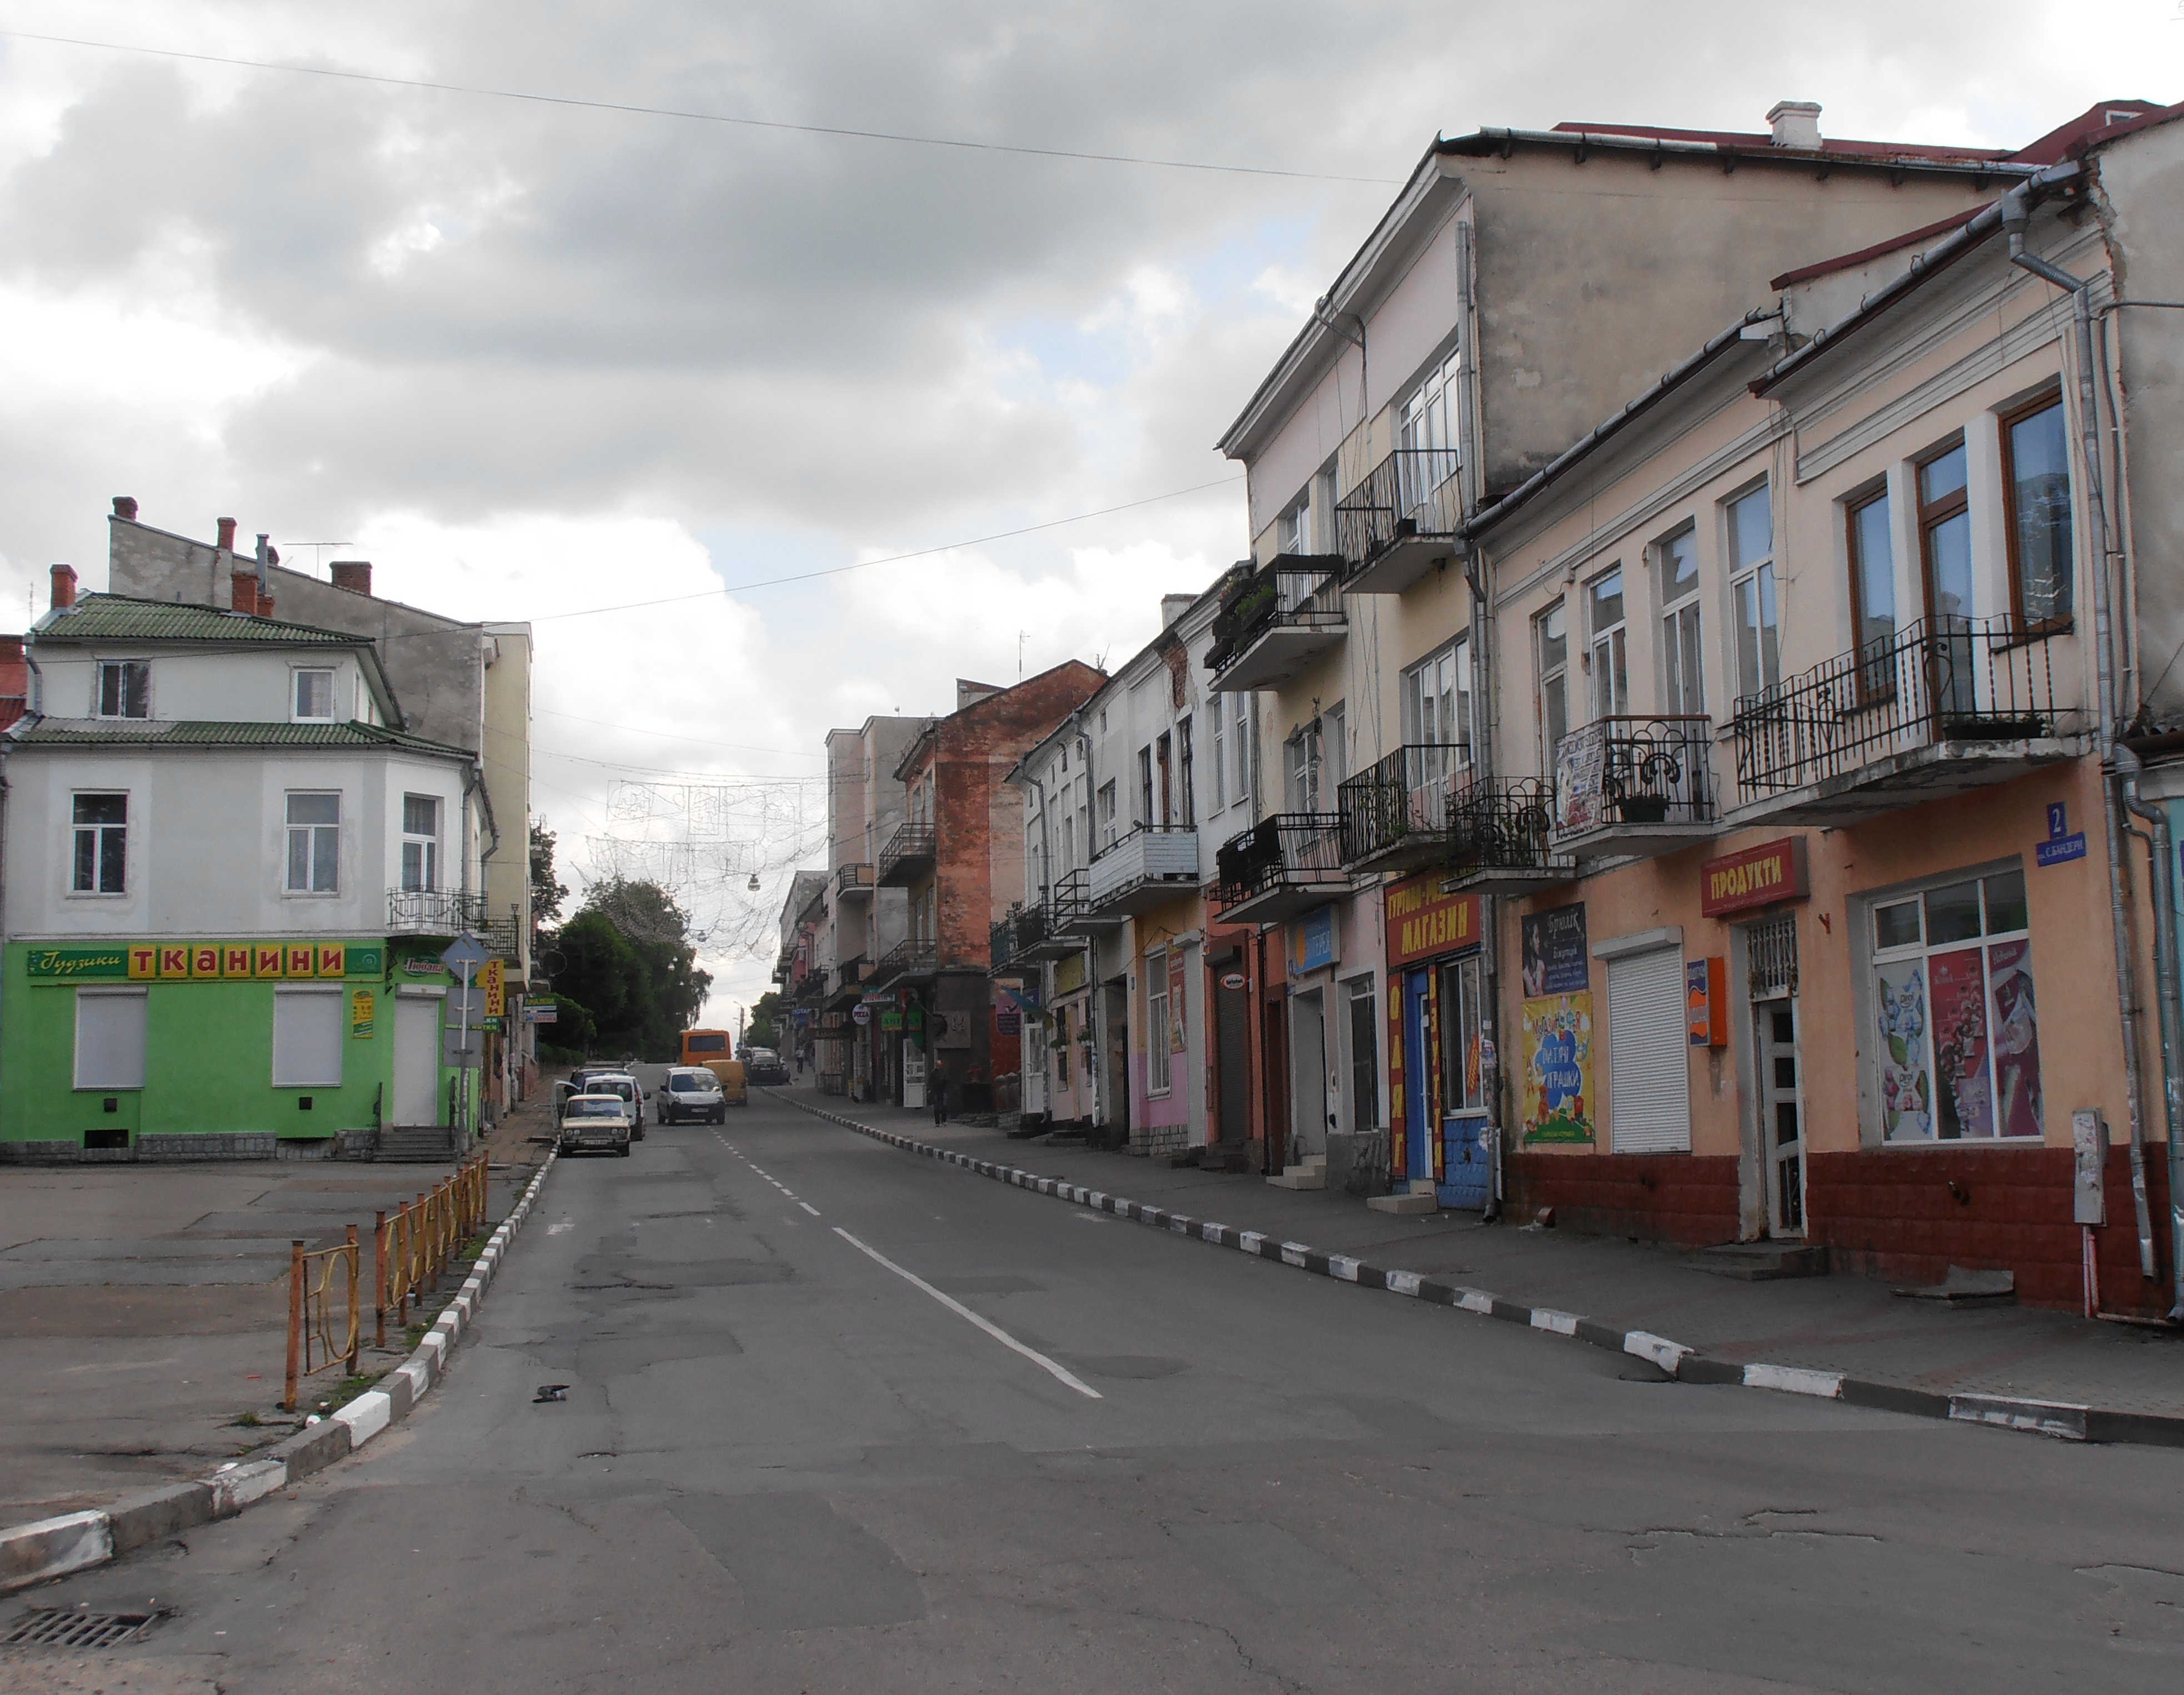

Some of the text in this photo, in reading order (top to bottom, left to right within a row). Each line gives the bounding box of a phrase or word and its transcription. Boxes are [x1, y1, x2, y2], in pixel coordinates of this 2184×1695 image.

[2052, 808, 2061, 833] 2
[1710, 855, 1782, 900] ПРОДУКТИ
[1401, 901, 1467, 955] МАГАЗИН
[404, 957, 444, 972] Любава
[1390, 986, 1404, 1168] ОДЯГ
[1430, 973, 1442, 1168] ВЗУТТЯ
